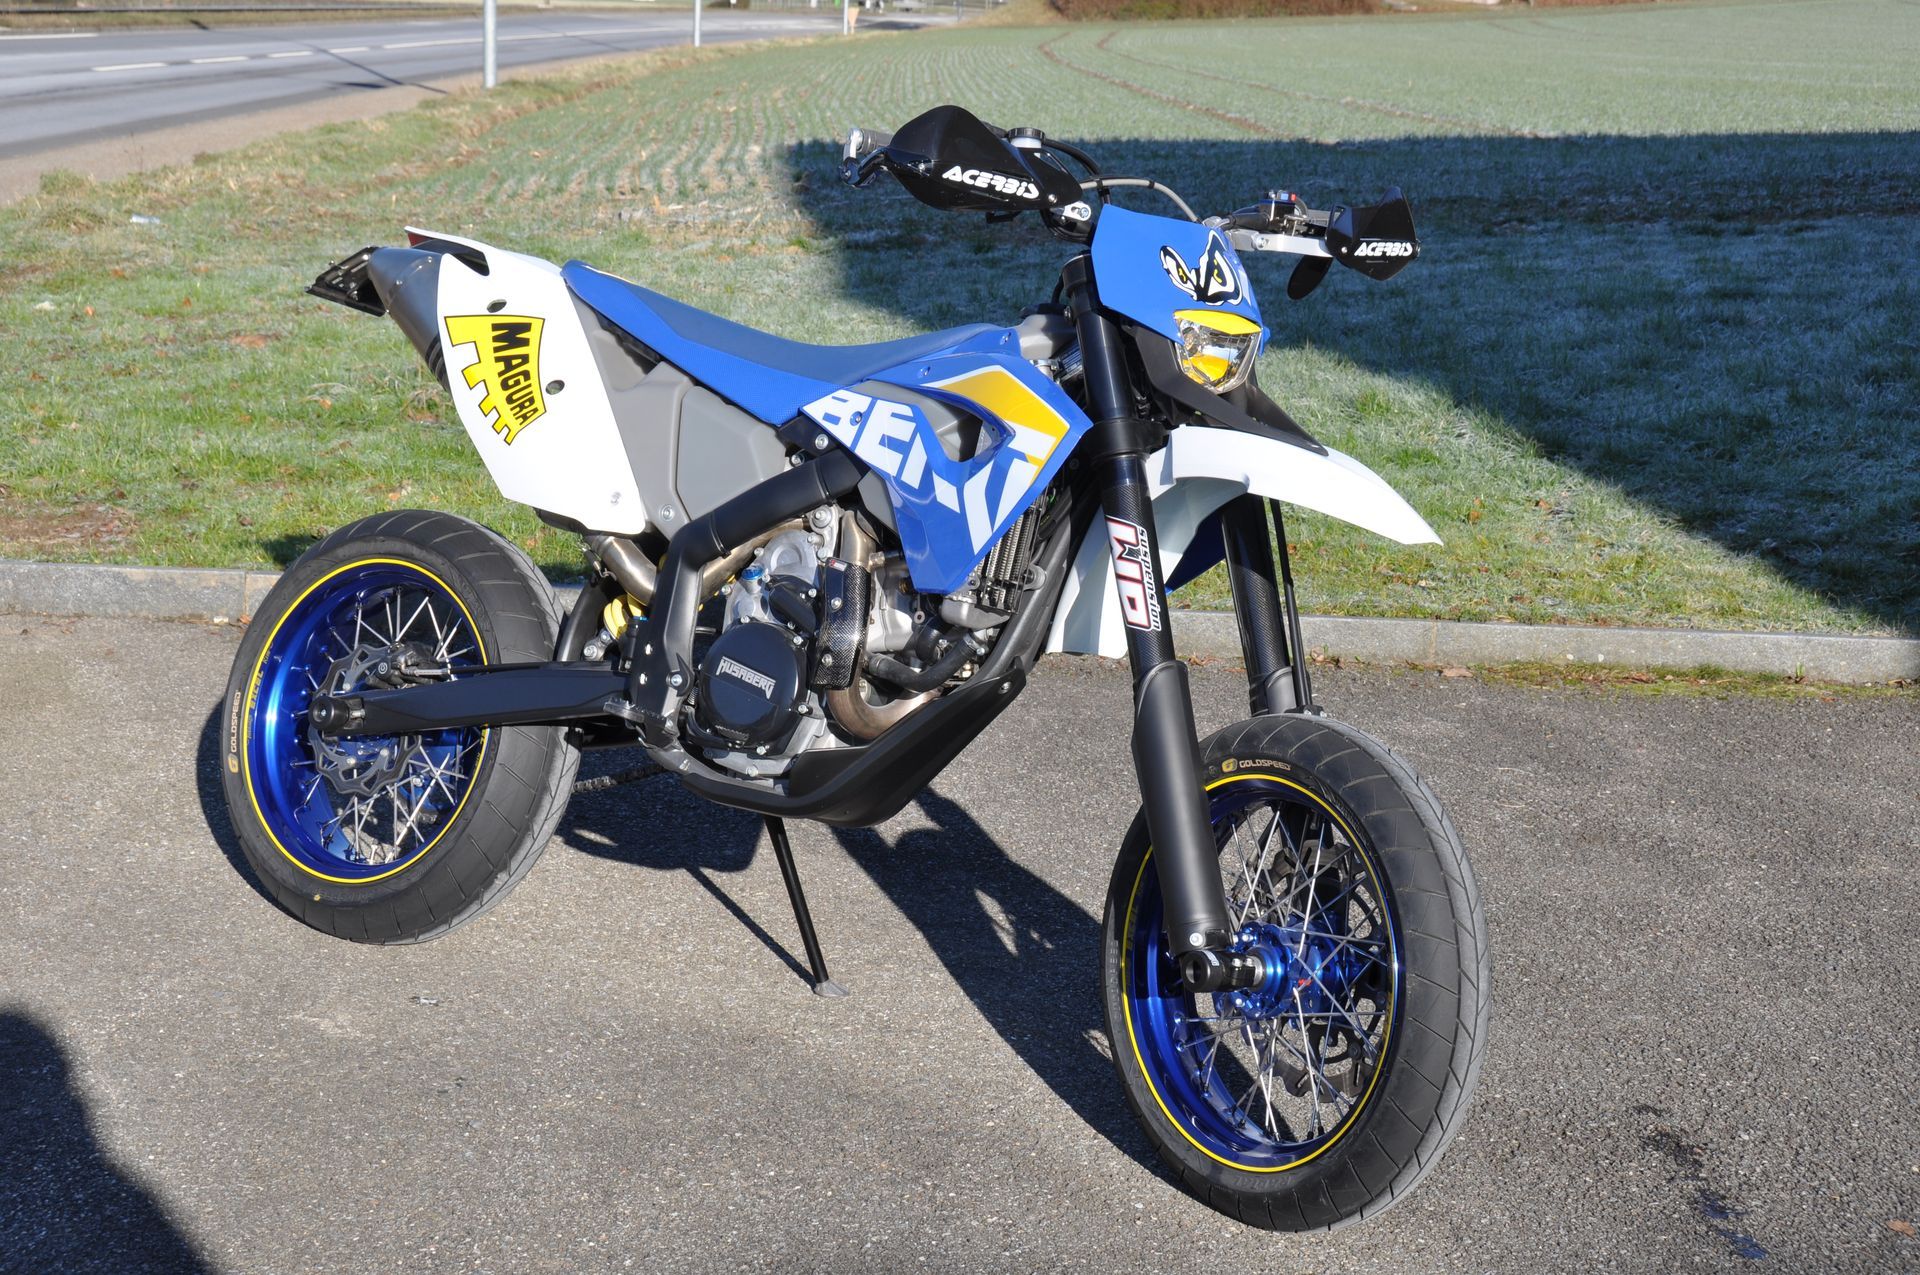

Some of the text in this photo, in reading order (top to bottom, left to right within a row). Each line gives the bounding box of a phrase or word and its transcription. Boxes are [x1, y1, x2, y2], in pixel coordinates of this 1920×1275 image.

[1353, 241, 1413, 257] ACERBIS
[491, 321, 539, 426] MAGURA
[1139, 526, 1161, 630] suspension
[715, 655, 776, 700] HUSABERG
[230, 690, 241, 753] GOLDSPEED
[1239, 759, 1291, 771] GOLDSPEED
